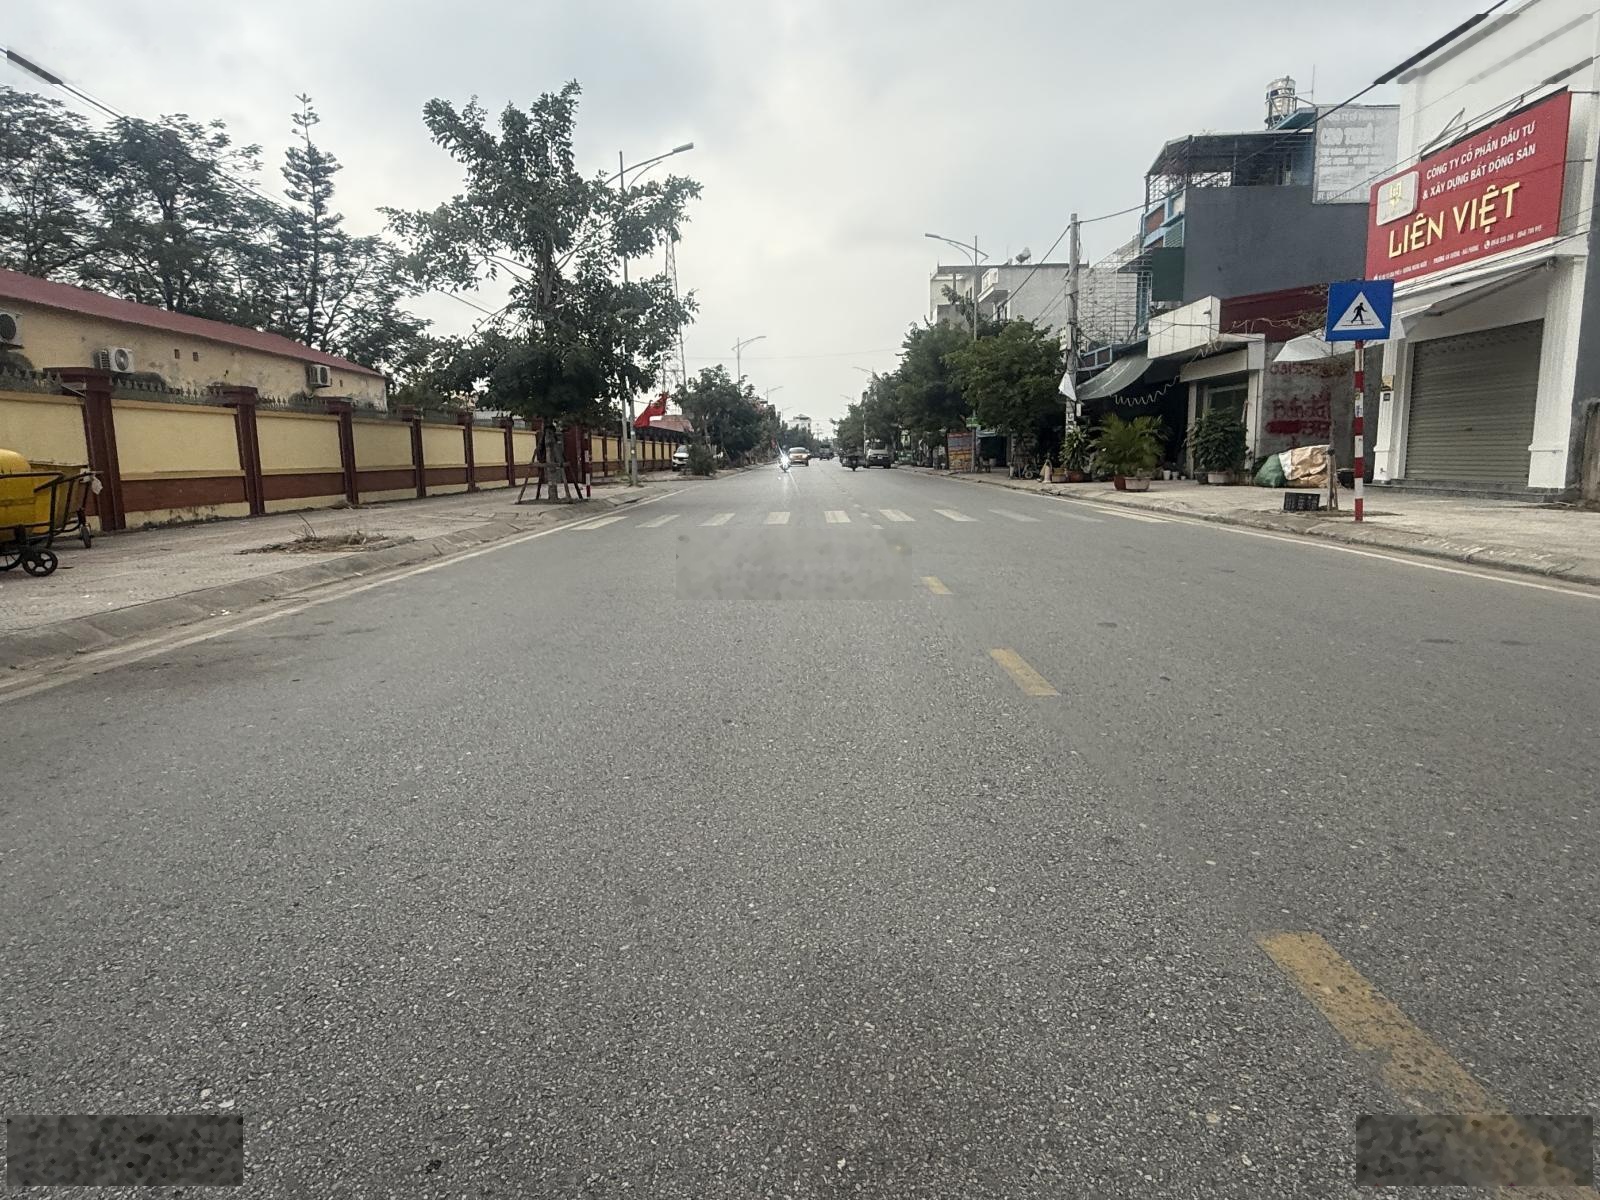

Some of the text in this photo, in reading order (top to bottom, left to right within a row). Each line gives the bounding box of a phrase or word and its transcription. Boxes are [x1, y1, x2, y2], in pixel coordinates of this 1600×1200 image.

[1422, 189, 1428, 200] &
[1430, 181, 1446, 197] XÂY
[1470, 161, 1487, 181] BẤT
[1516, 141, 1536, 161] SẢN
[1426, 163, 1448, 180] CÔNG
[1449, 156, 1460, 170] TY
[1461, 144, 1473, 165] CỔ
[1474, 136, 1498, 159] PHẦN
[1522, 120, 1536, 137] TƯ
[1388, 211, 1445, 258] LIÊN
[1453, 181, 1520, 234] VIỆT
